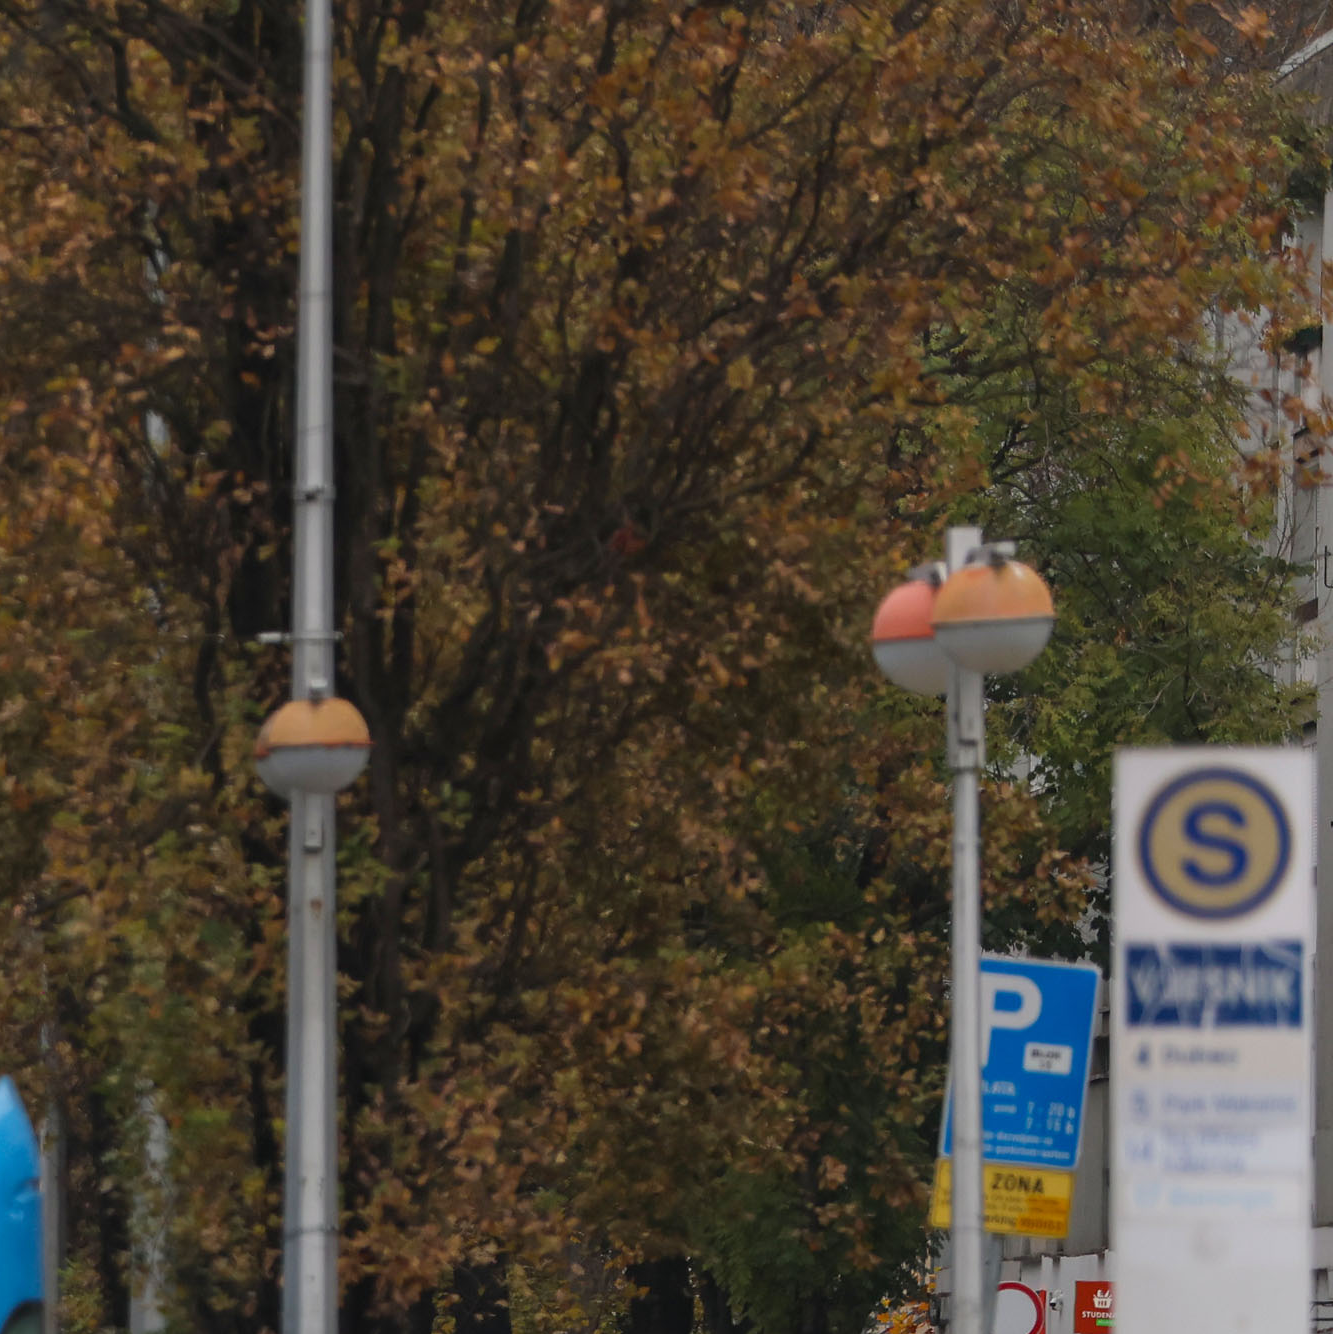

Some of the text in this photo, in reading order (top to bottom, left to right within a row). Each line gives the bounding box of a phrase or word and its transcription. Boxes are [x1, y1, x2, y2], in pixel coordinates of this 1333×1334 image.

[1179, 801, 1252, 888] S
[980, 972, 1042, 1070] P
[991, 1172, 1044, 1194] ZONA
